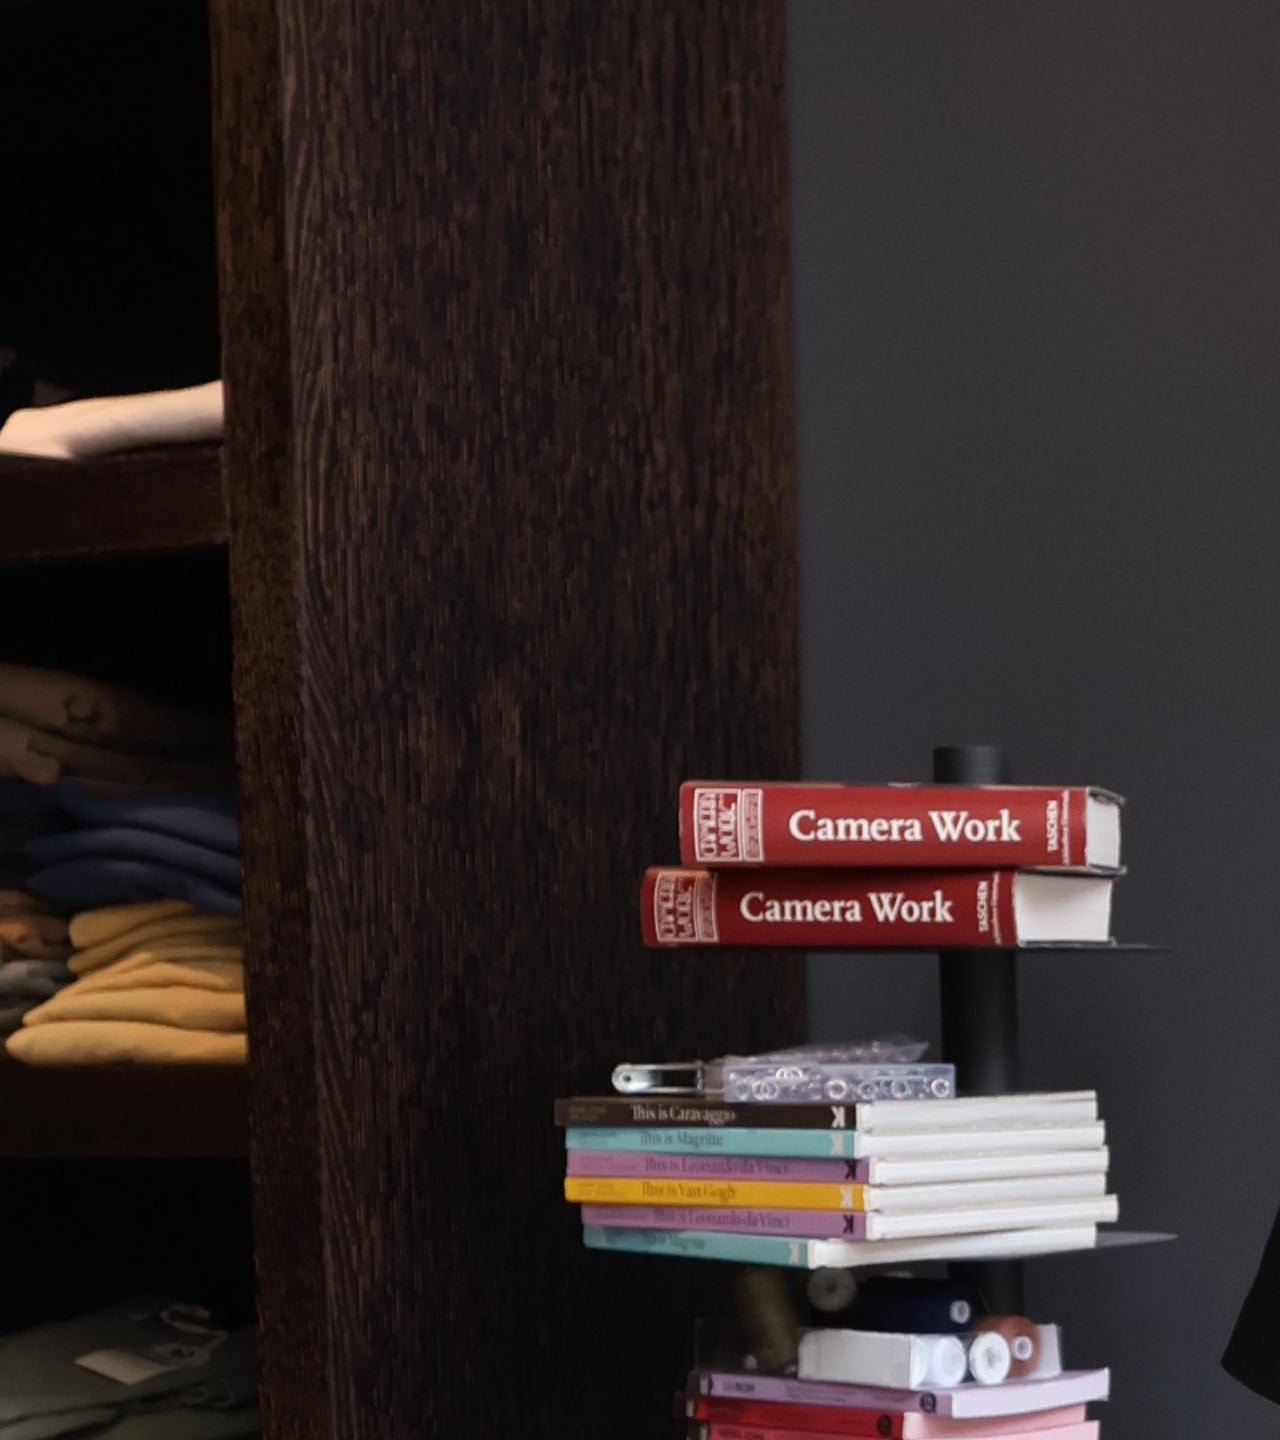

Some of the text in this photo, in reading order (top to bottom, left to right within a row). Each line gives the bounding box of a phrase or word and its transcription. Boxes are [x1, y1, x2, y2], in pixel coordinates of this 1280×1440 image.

[788, 809, 923, 842] Camera
[929, 808, 1021, 843] Work
[1047, 800, 1059, 852] TASCHEN
[739, 891, 862, 923] Camera
[868, 891, 953, 923] Work
[977, 880, 989, 933] TASCHEN
[631, 1105, 736, 1125] This is Caravaggio
[640, 1130, 723, 1149] This is Magritte
[645, 1159, 667, 1173] This
[669, 1160, 679, 1173] is
[682, 1159, 737, 1174] Leonardo
[642, 1181, 664, 1197] This
[666, 1183, 676, 1197] is
[678, 1183, 700, 1198] Van
[703, 1183, 736, 1203] Gogh
[688, 1211, 740, 1226] Leonardo
